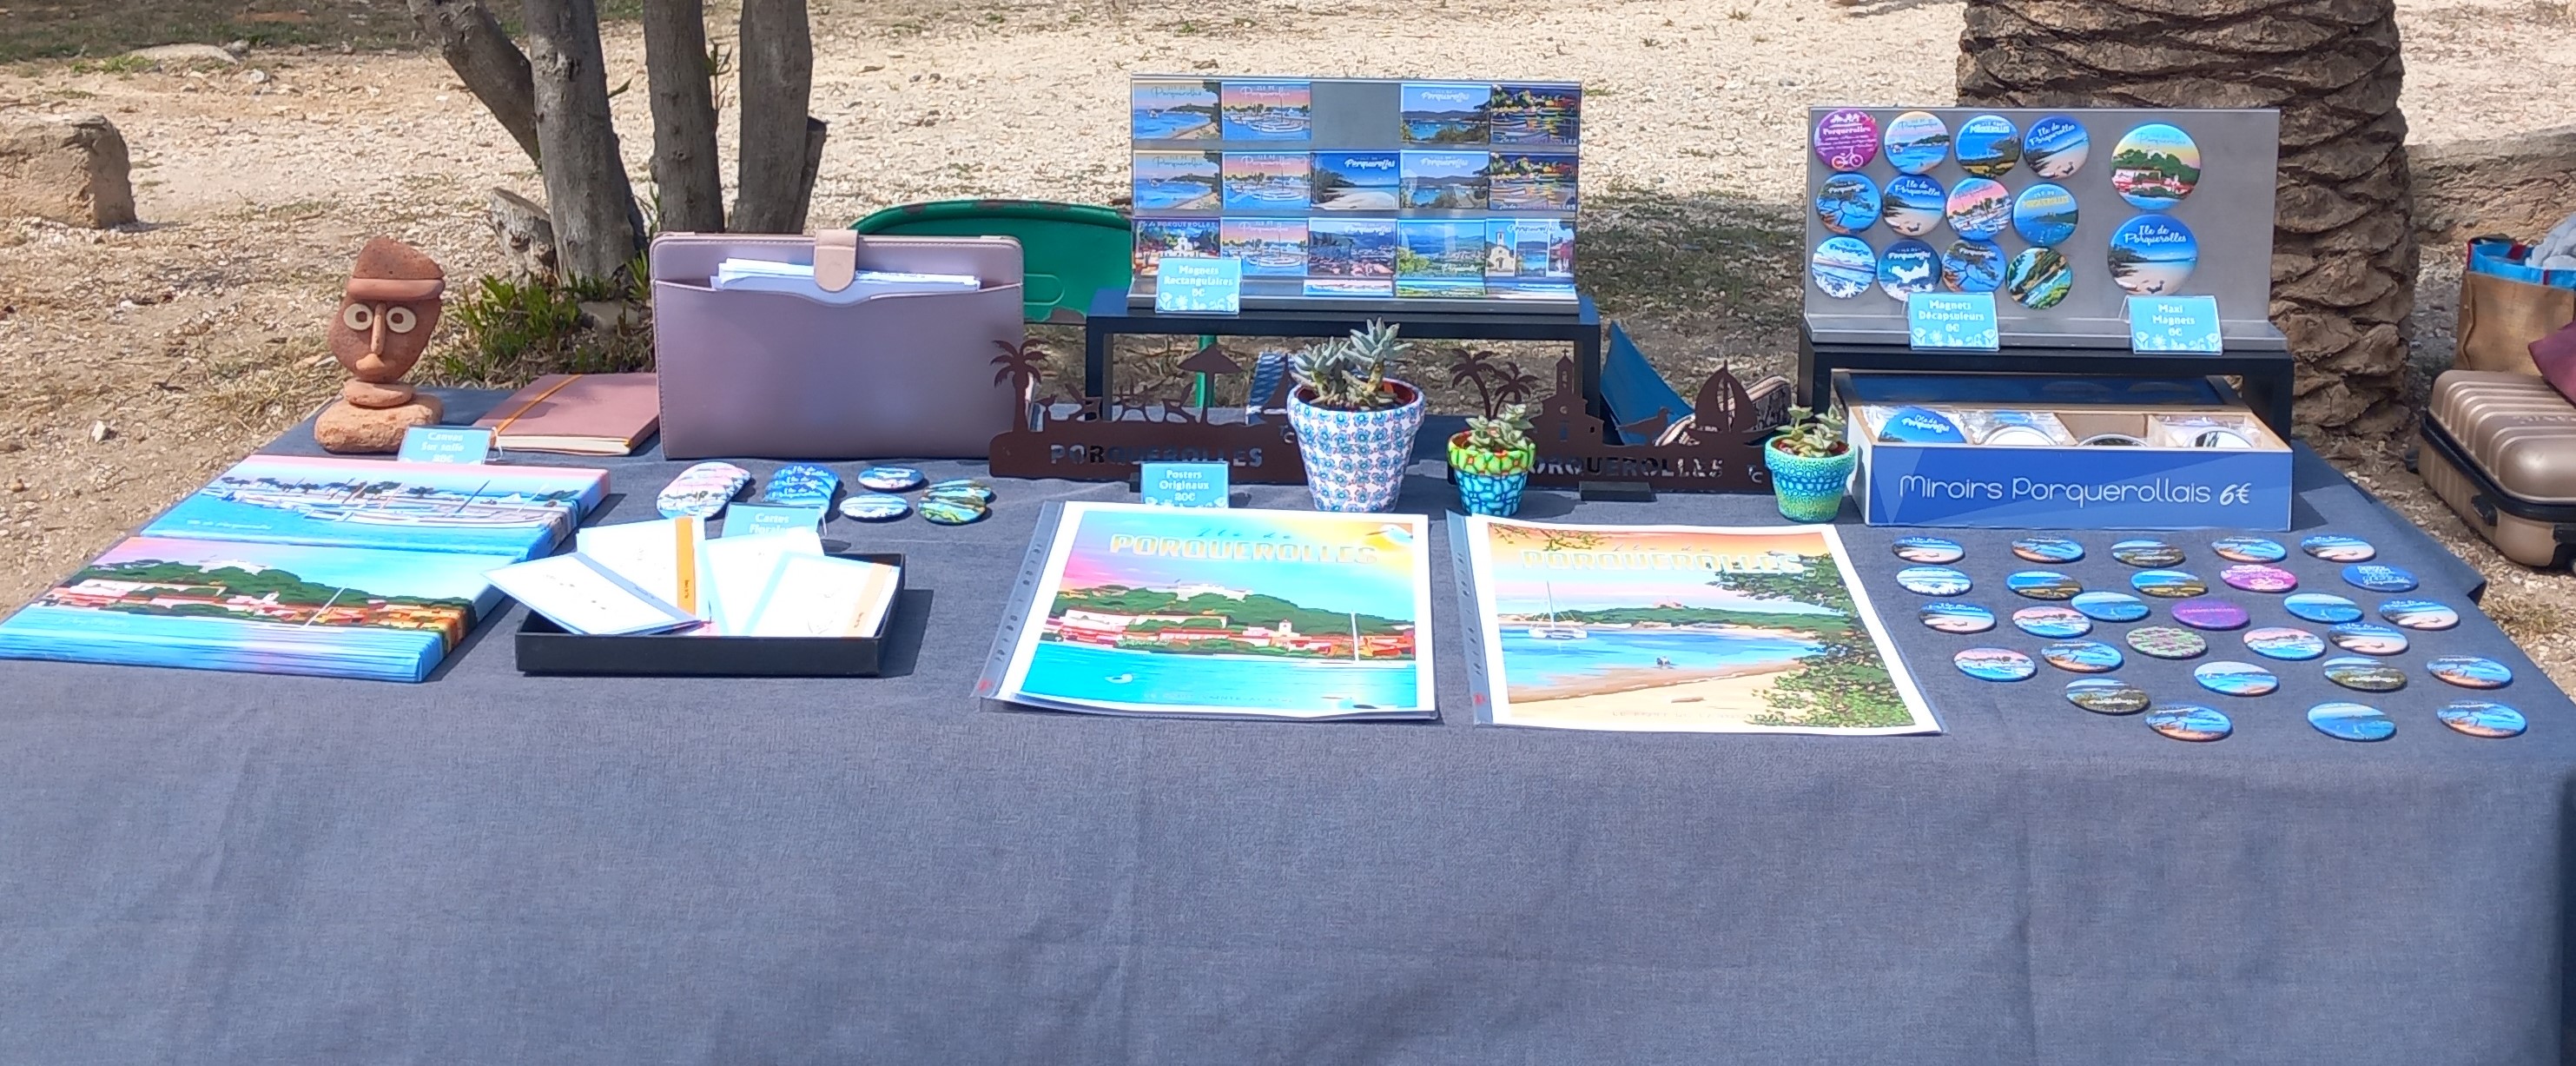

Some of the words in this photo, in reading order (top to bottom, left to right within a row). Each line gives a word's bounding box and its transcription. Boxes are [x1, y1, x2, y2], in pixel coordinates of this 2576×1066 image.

[2139, 225, 2155, 235] Ile
[2157, 224, 2170, 235] de
[2124, 232, 2187, 246] Porquerolles
[1179, 265, 1219, 275] Magnets
[1164, 276, 1233, 288] Rectangulaires
[1929, 300, 1972, 310] Magnets
[2157, 304, 2183, 313] Maxi
[1918, 310, 1985, 321] Décapsuleurs
[2152, 315, 2196, 325] Magnets
[1529, 457, 1724, 478] ORQUEROLLES
[1166, 469, 1202, 479] Posters
[1159, 480, 1210, 491] Originaux
[1899, 474, 2003, 500] Miroirs
[2011, 477, 2211, 508] Porquerollais
[2218, 481, 2253, 507] 6€
[755, 513, 789, 523] Cartes
[1109, 533, 1377, 564] PORQUEROLLES
[1521, 549, 1805, 575] PORQUEROLLES
